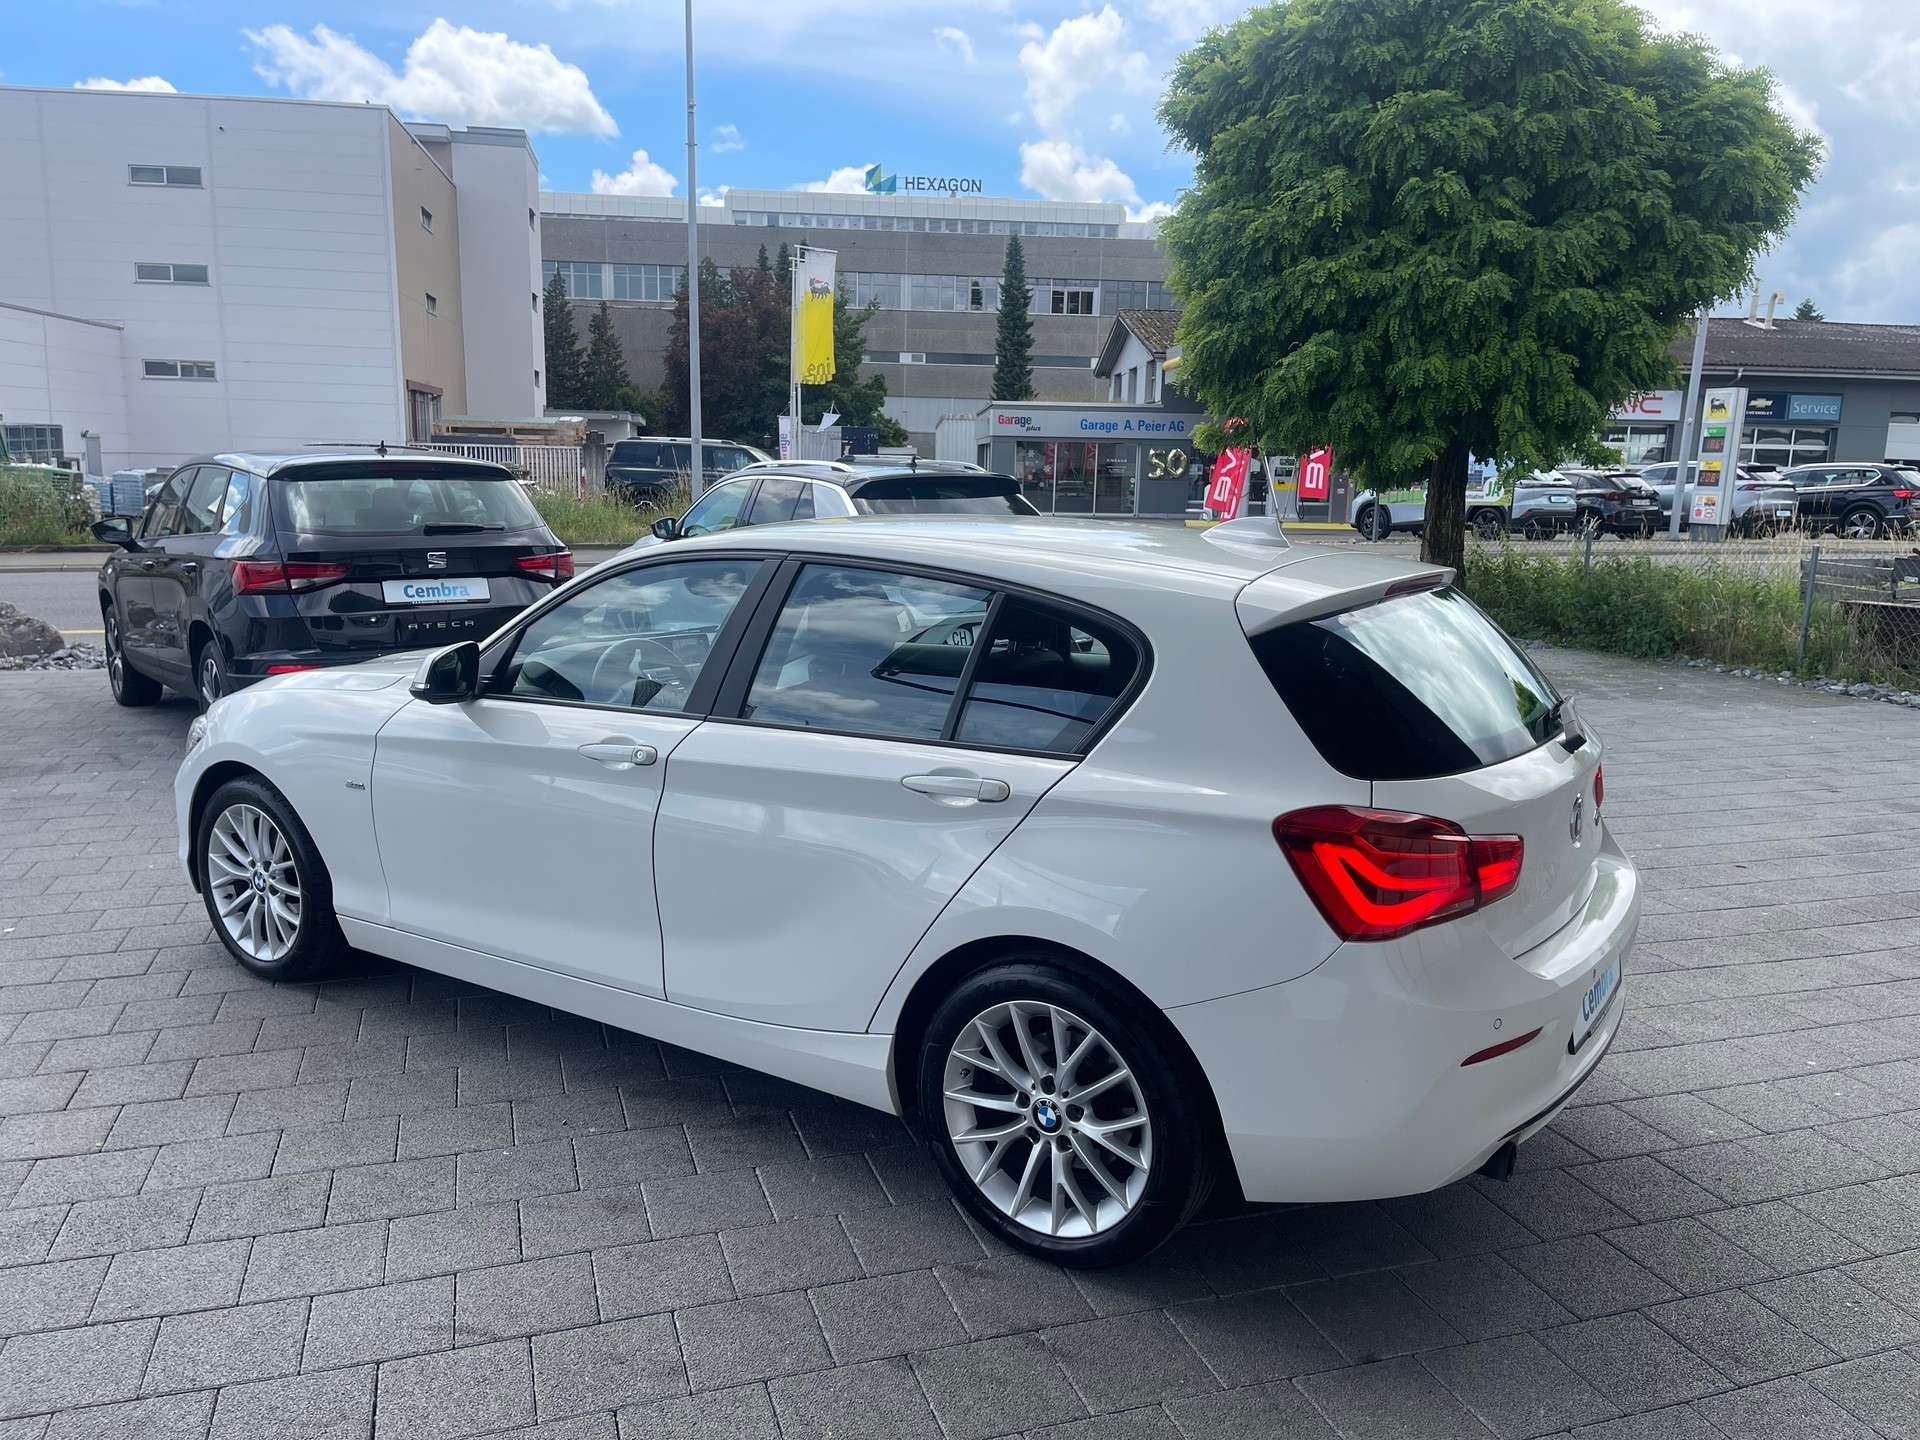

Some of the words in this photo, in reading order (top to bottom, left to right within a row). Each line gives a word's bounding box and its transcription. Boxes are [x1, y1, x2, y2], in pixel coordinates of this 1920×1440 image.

[905, 176, 982, 193] HEXAGON
[807, 357, 830, 376] eni
[1793, 401, 1837, 414] Service
[998, 415, 1032, 427] Garage
[1080, 419, 1118, 433] Garage
[1124, 420, 1135, 432] A.
[1138, 420, 1166, 432] Peier
[1168, 420, 1185, 432] AG
[1148, 448, 1187, 479] 50
[1485, 481, 1500, 497] JA
[403, 583, 470, 599] Cembra
[408, 620, 475, 631] ATECA
[952, 631, 967, 645] CH
